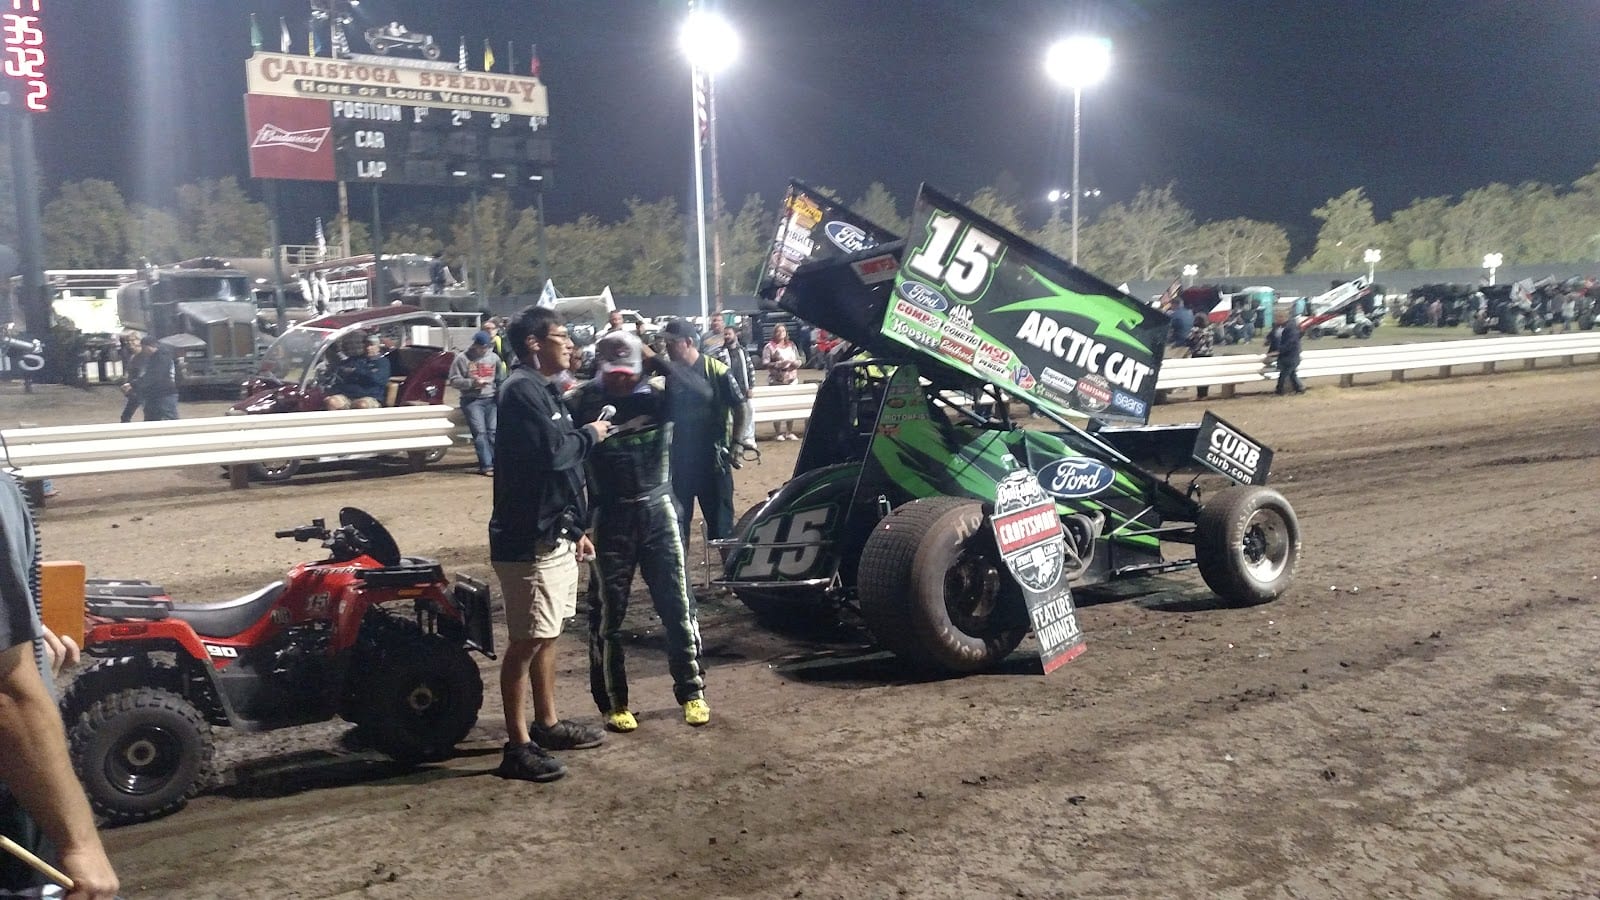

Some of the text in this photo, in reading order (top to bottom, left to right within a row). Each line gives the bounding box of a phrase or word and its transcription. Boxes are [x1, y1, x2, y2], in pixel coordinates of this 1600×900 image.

[27, 80, 48, 110] 2
[262, 58, 536, 103] CALISTOGA SPEEDWAY
[301, 80, 507, 107] HOME OF LOUIE VERMEIL
[333, 100, 402, 122] POSITION
[355, 130, 385, 149] CAR
[356, 160, 387, 178] LAP
[910, 213, 1001, 295] 15
[908, 284, 941, 308] Ford
[980, 343, 1011, 362] MSD
[1016, 310, 1150, 394] ARCTIC CAT
[1115, 393, 1144, 414] sears
[1210, 427, 1261, 469] CURB
[1052, 461, 1105, 491] Ford
[1206, 452, 1252, 485] curb.com
[739, 507, 830, 577] 15
[999, 509, 1057, 545] CRAFTSMAN
[1032, 594, 1073, 630] FEATURE
[1037, 613, 1080, 652] WINNER
[206, 644, 238, 658] 90
